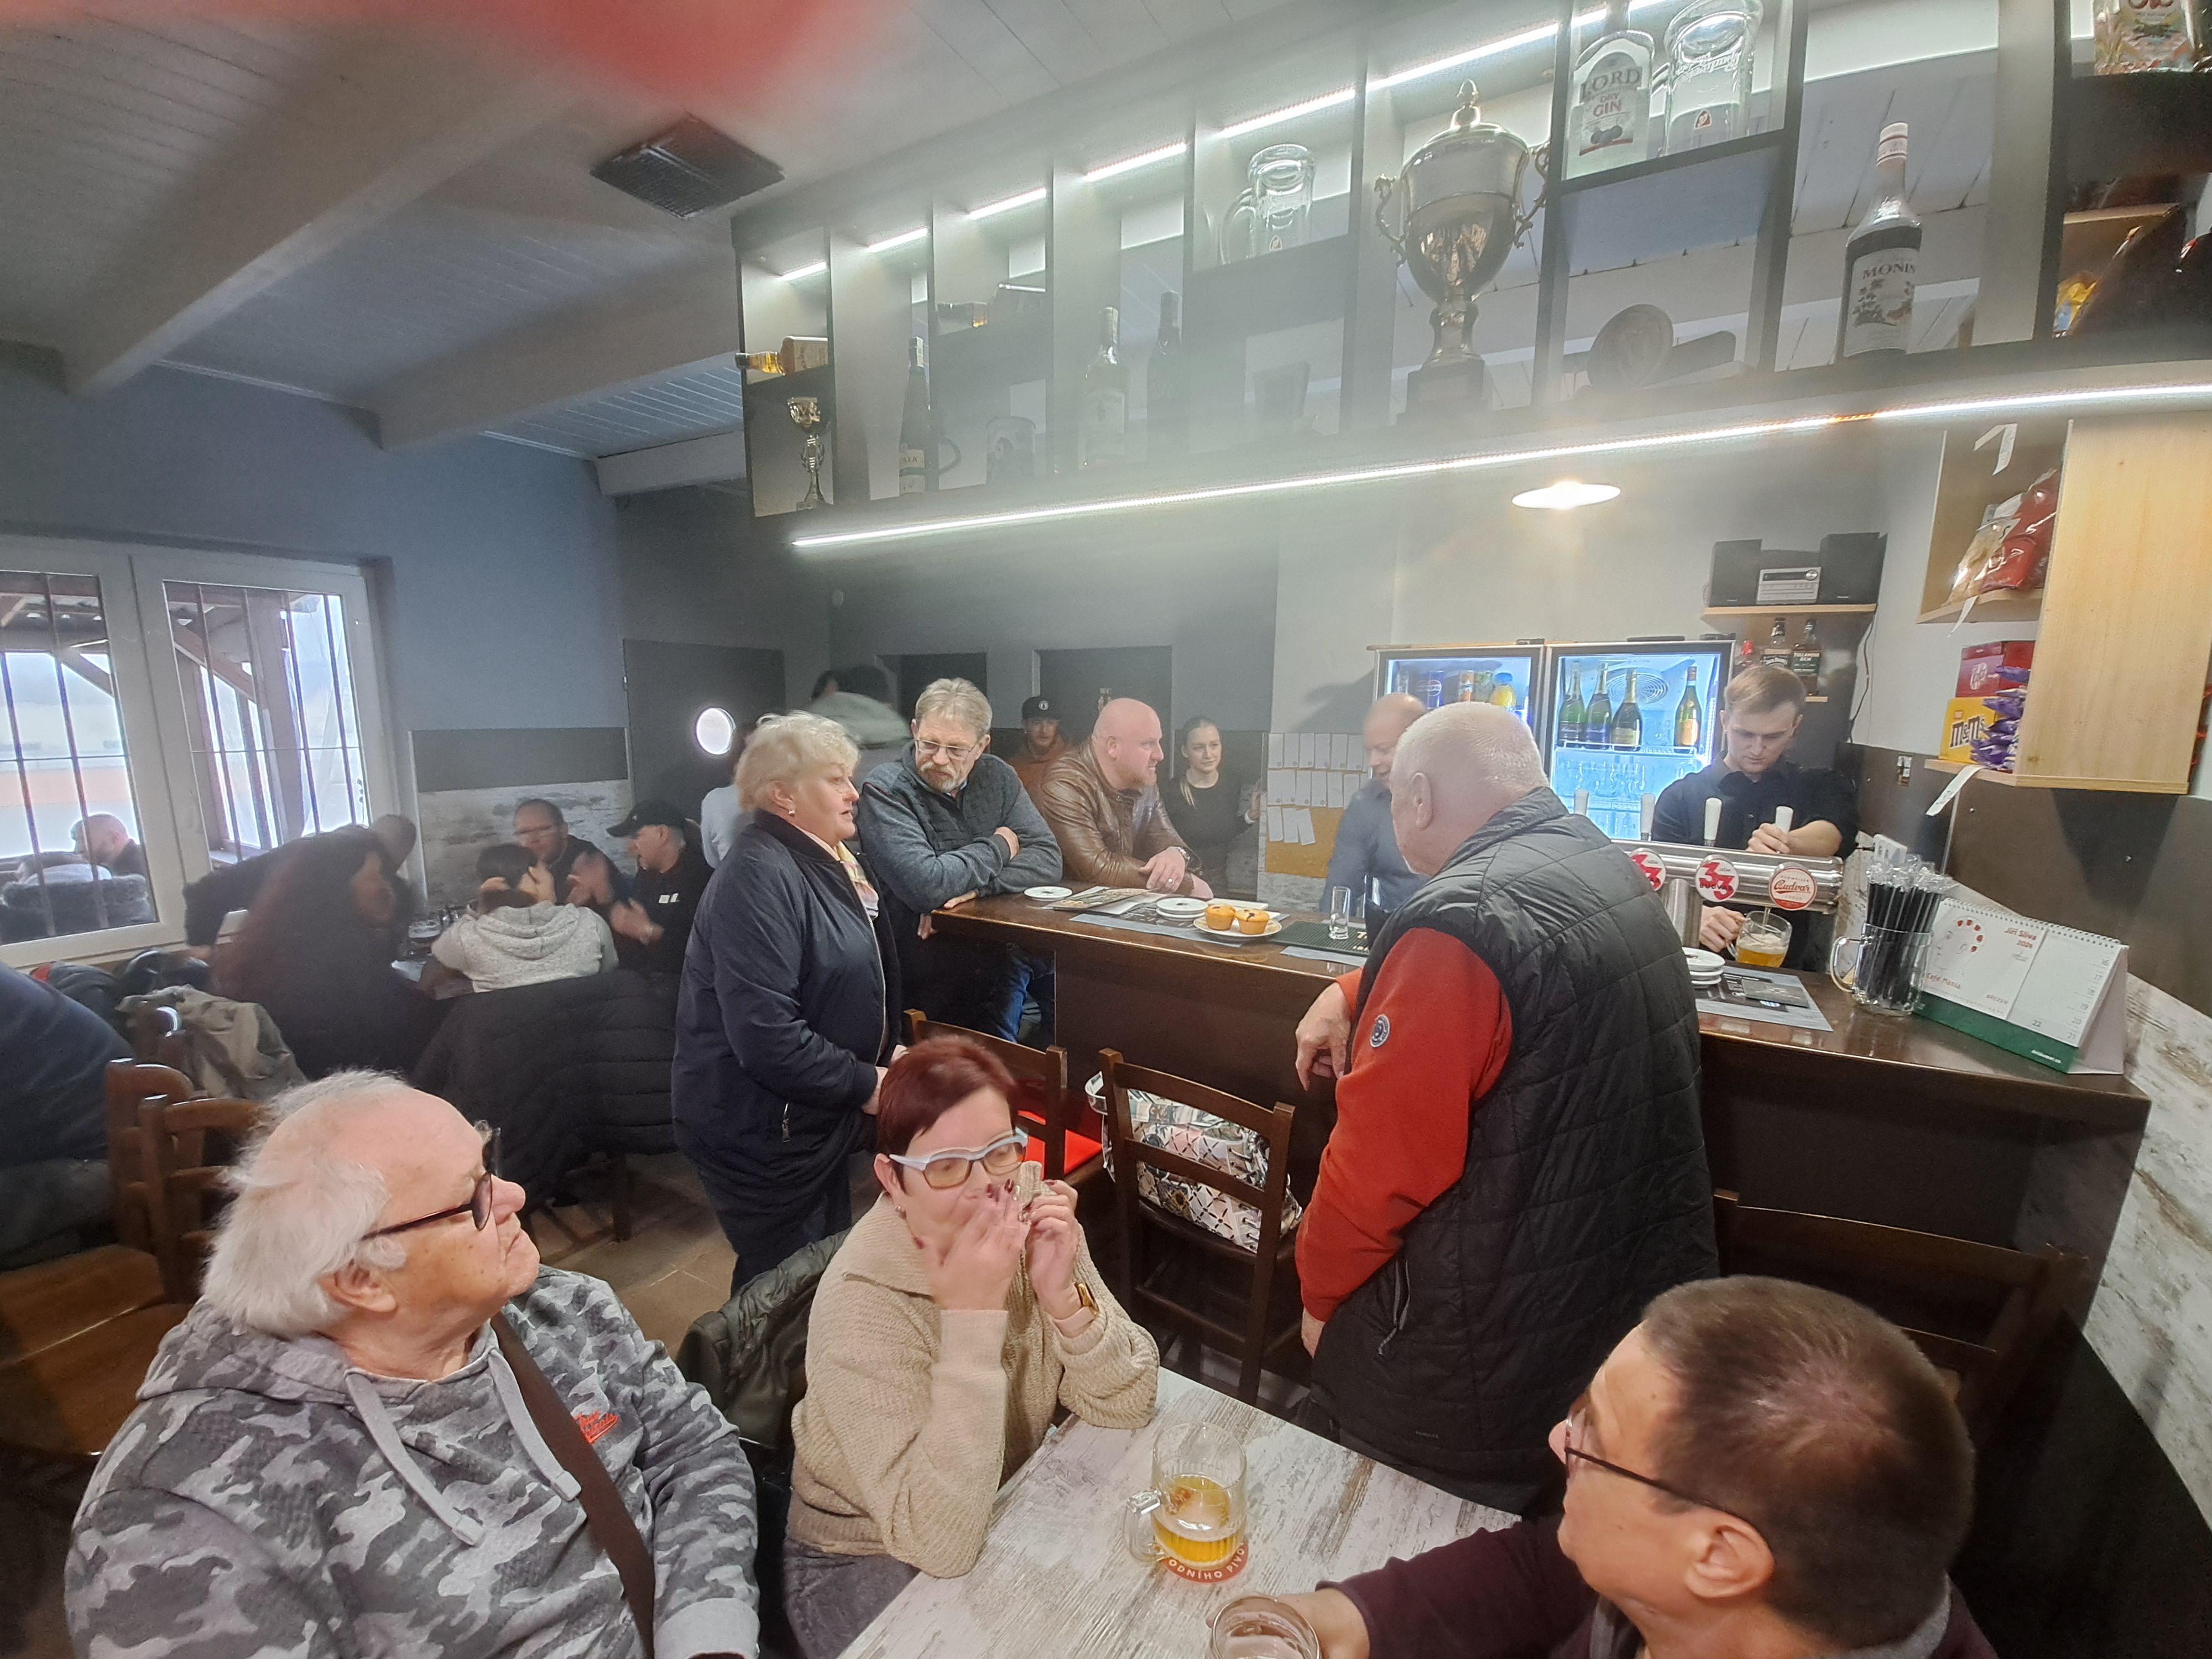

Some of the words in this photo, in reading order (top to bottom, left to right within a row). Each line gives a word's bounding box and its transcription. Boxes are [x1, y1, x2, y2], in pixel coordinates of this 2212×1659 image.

[1580, 67, 1641, 102] LORD
[1600, 92, 1620, 102] DRY
[1593, 100, 1621, 117] GIN
[1773, 879, 1811, 892] Budvar
[2032, 1019, 2042, 1027] 22
[1168, 1558, 1223, 1580] ODNÍHO
[1225, 1543, 1245, 1573] PIVO
